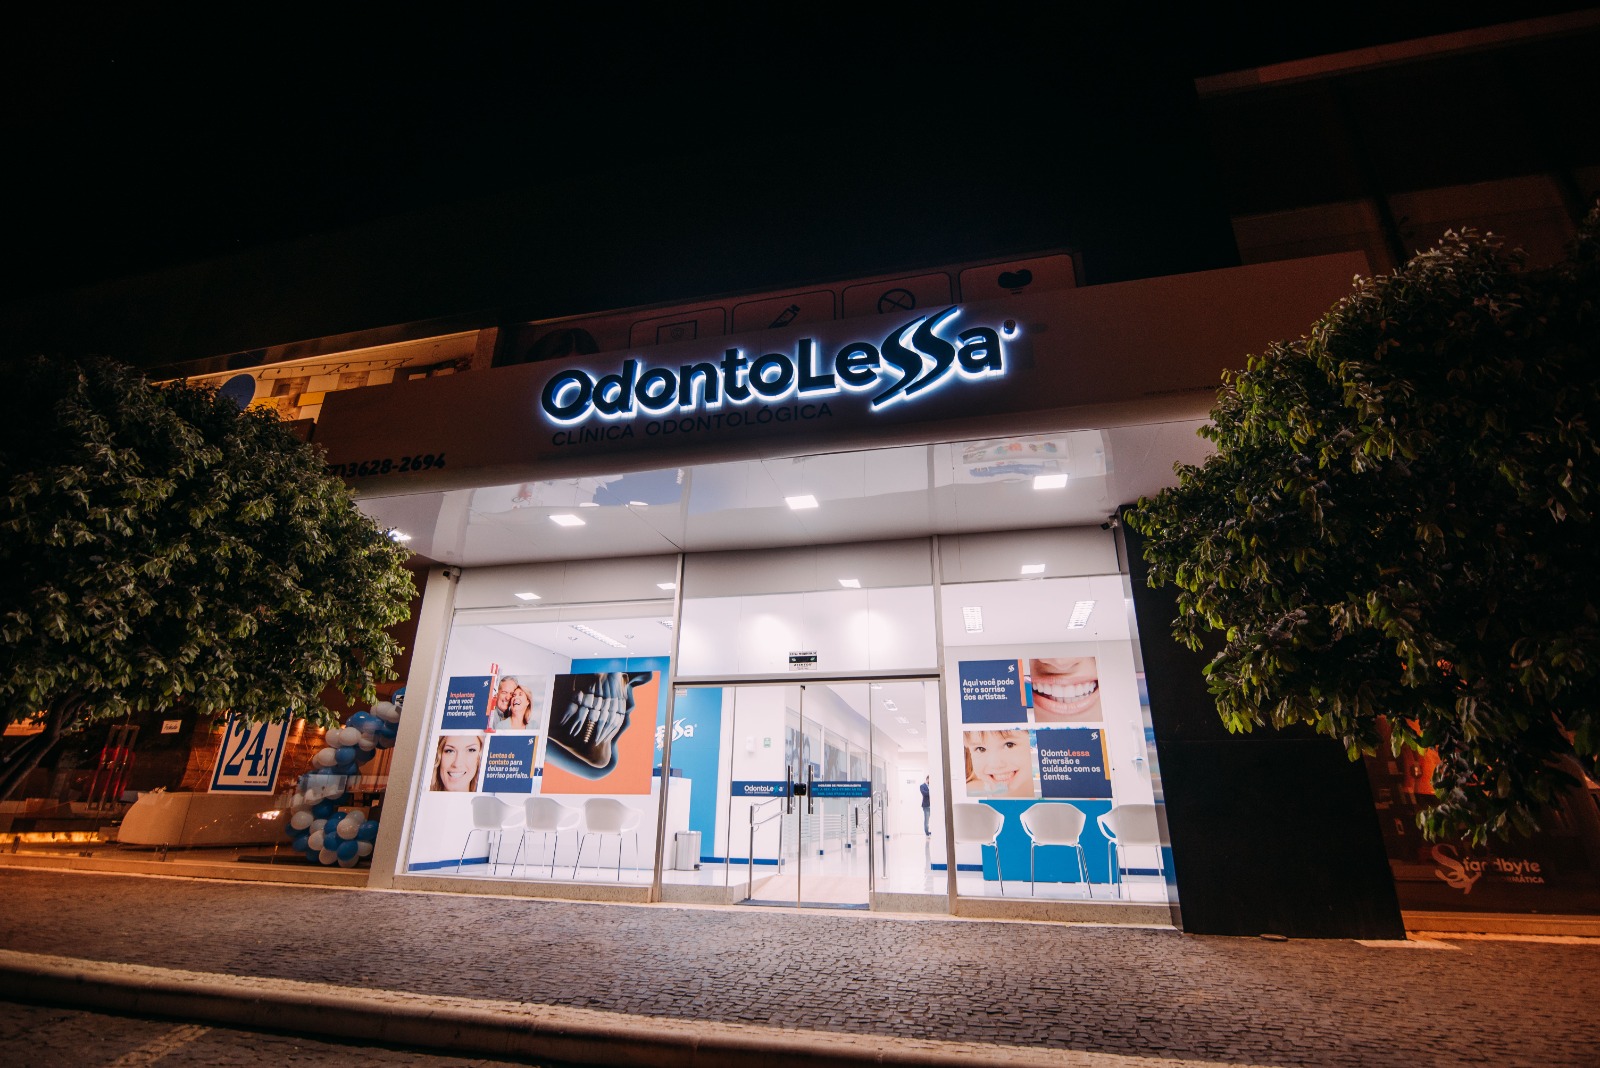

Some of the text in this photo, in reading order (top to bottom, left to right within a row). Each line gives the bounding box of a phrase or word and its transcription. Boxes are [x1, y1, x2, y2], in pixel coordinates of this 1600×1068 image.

[551, 402, 833, 446] CLÍNICA ODONTOLÓGICA
[962, 677, 1015, 688] Aqui você pode
[964, 692, 1008, 701] dos artistas.
[1042, 756, 1074, 765] diversão
[1043, 773, 1072, 781] dentes.
